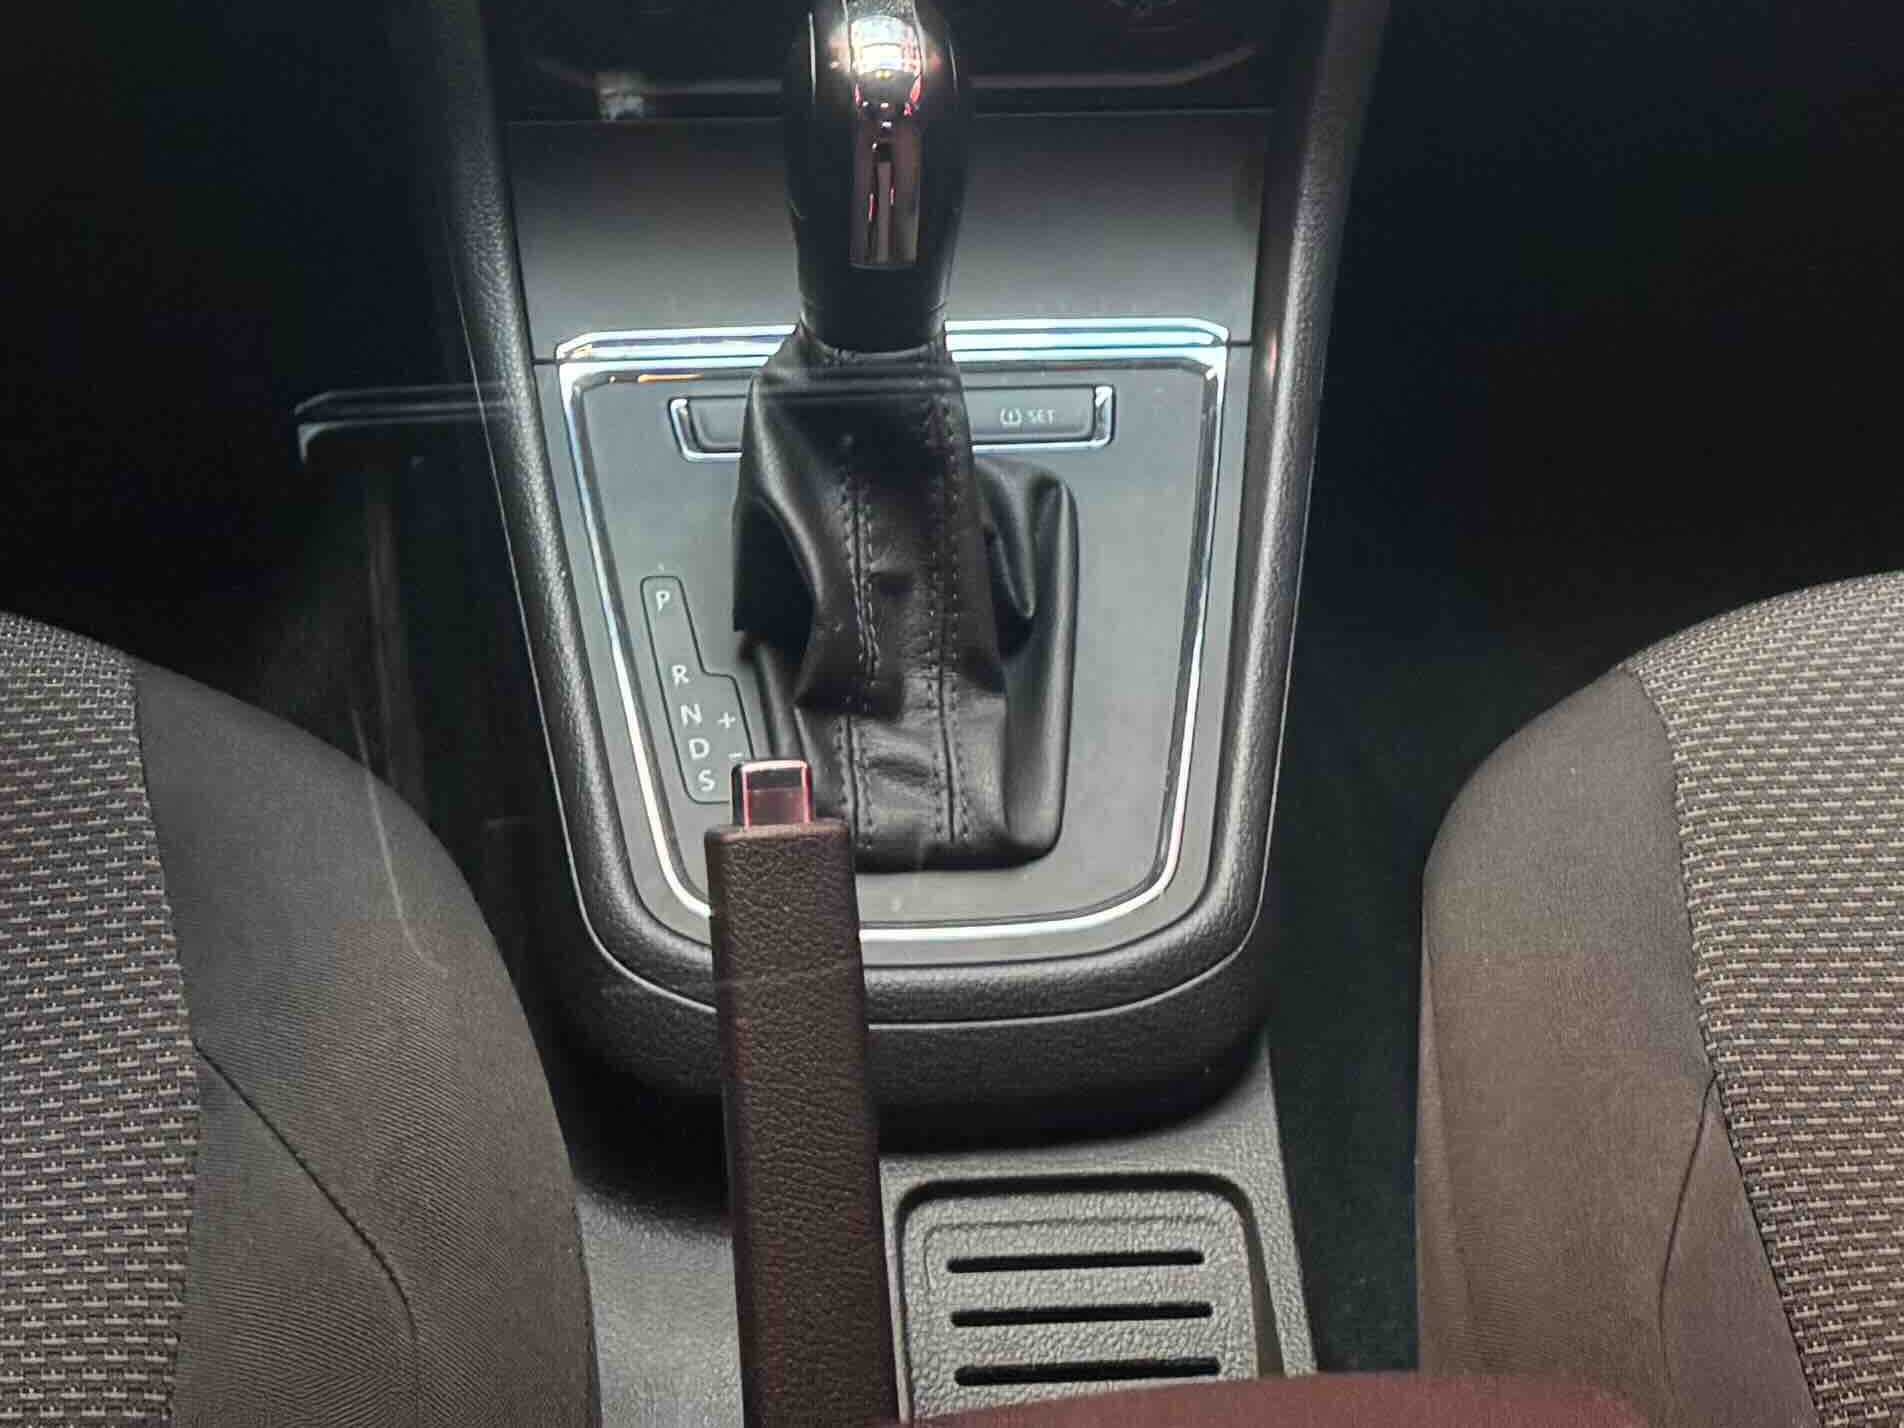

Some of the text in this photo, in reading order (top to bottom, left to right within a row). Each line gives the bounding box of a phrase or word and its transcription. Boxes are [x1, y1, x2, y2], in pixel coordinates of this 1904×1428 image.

[1026, 408, 1057, 425] SET
[655, 589, 671, 612] P
[671, 663, 689, 687] R
[680, 703, 703, 727] N
[688, 737, 711, 761] D
[697, 768, 716, 793] S
